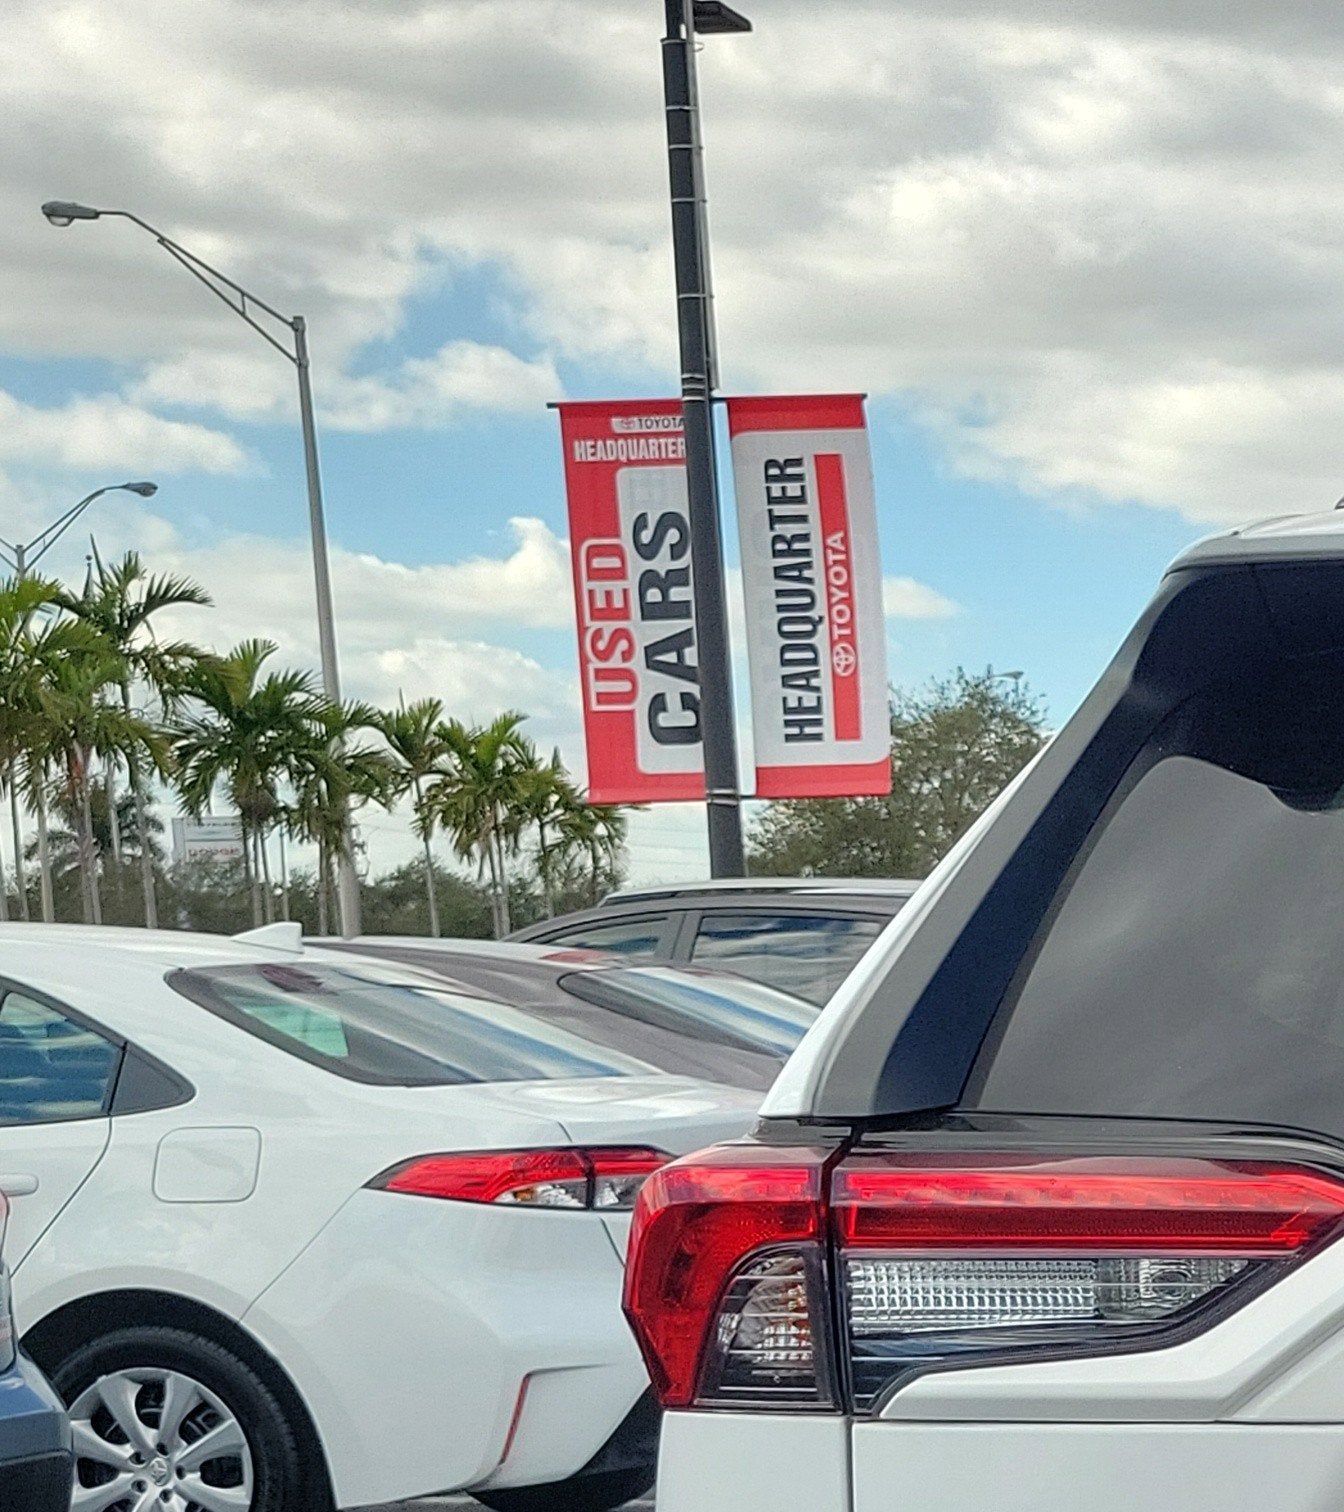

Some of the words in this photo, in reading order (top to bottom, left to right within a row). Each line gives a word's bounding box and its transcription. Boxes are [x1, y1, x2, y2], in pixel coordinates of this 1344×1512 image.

[574, 437, 686, 462] HEADQUARTER
[638, 417, 685, 430] TOYOTA
[584, 540, 637, 710] USED
[632, 510, 702, 746] CARS
[763, 456, 825, 743] HEADQUARTER
[825, 530, 855, 639] TOYOTA
